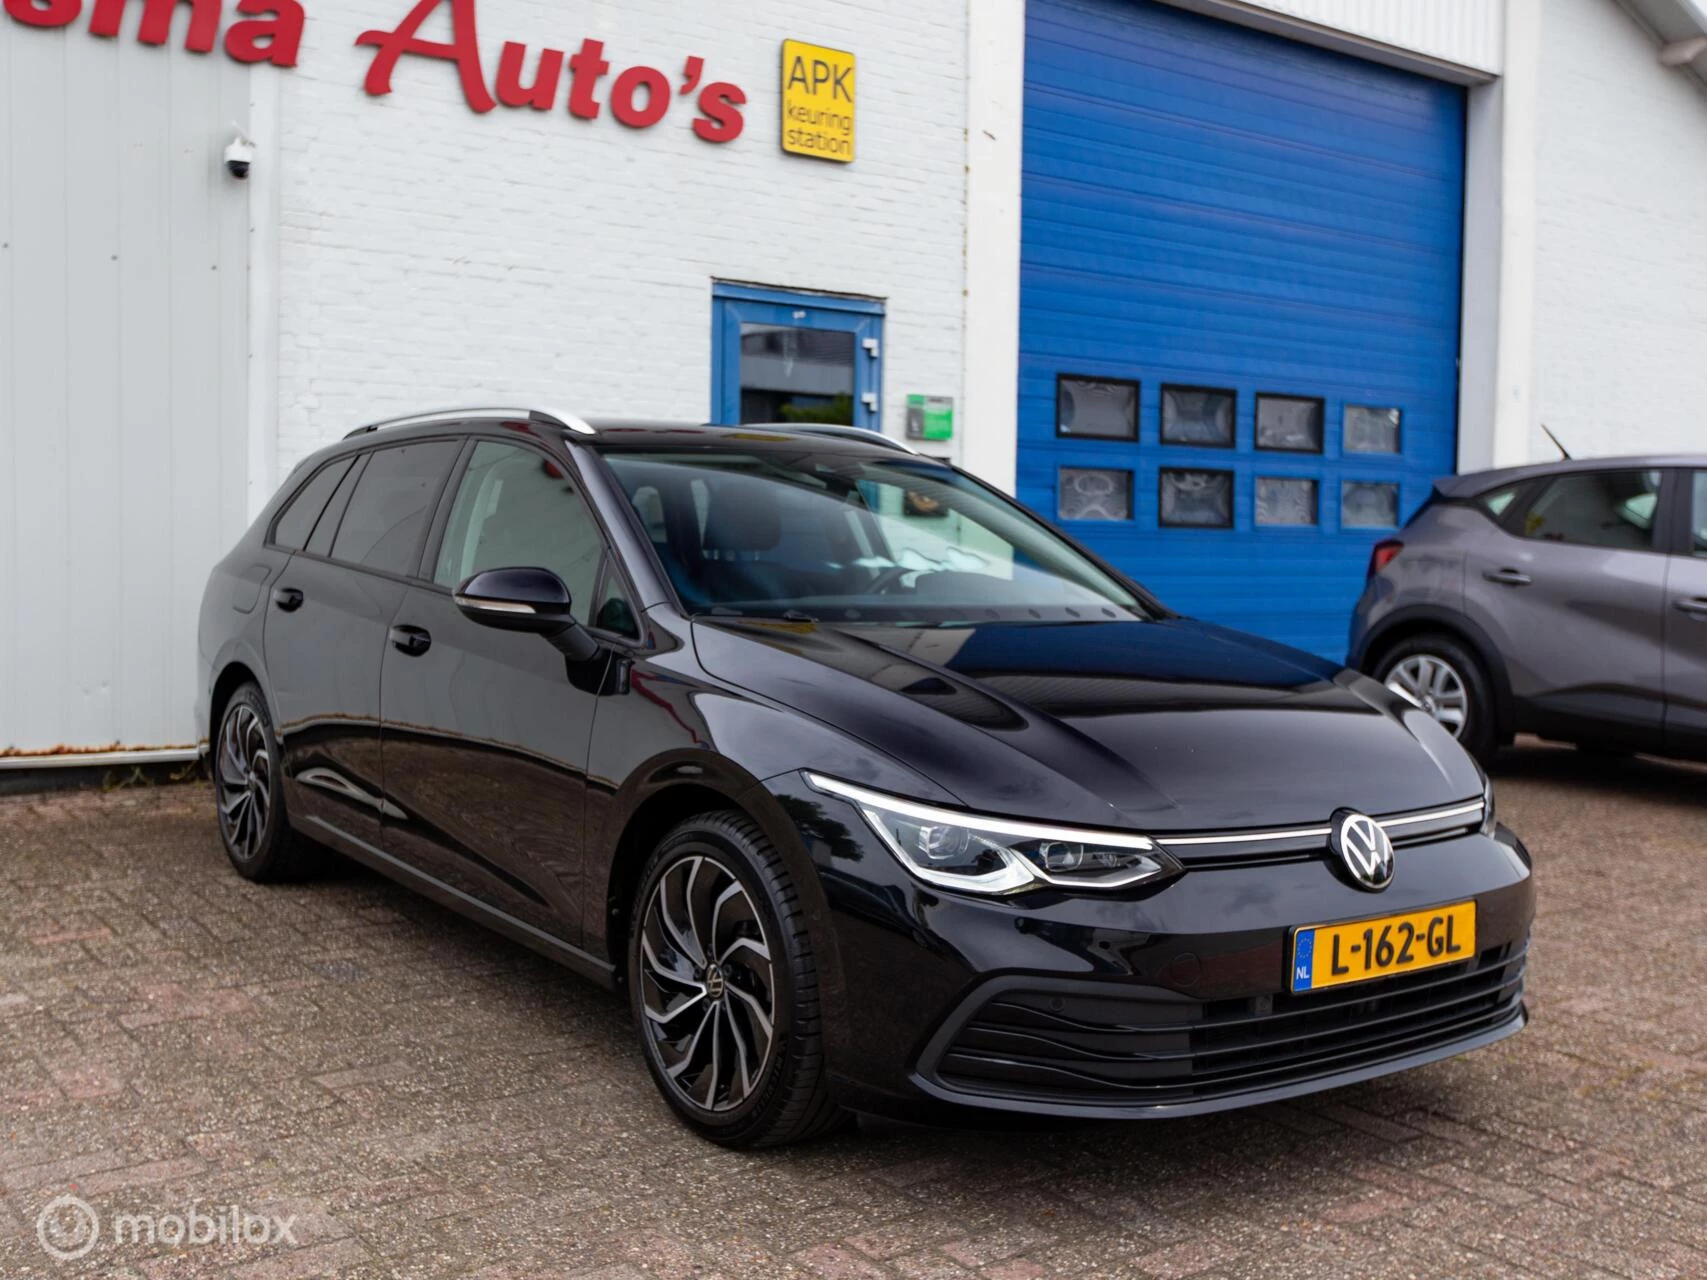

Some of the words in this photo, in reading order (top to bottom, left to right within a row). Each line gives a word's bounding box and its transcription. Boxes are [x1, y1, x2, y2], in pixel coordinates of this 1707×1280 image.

[355, 0, 747, 143] Auto's
[787, 55, 852, 103] APK
[787, 100, 851, 136] keuring
[787, 127, 851, 155] station
[1331, 914, 1461, 976] L-162-GL
[1296, 966, 1310, 979] NL
